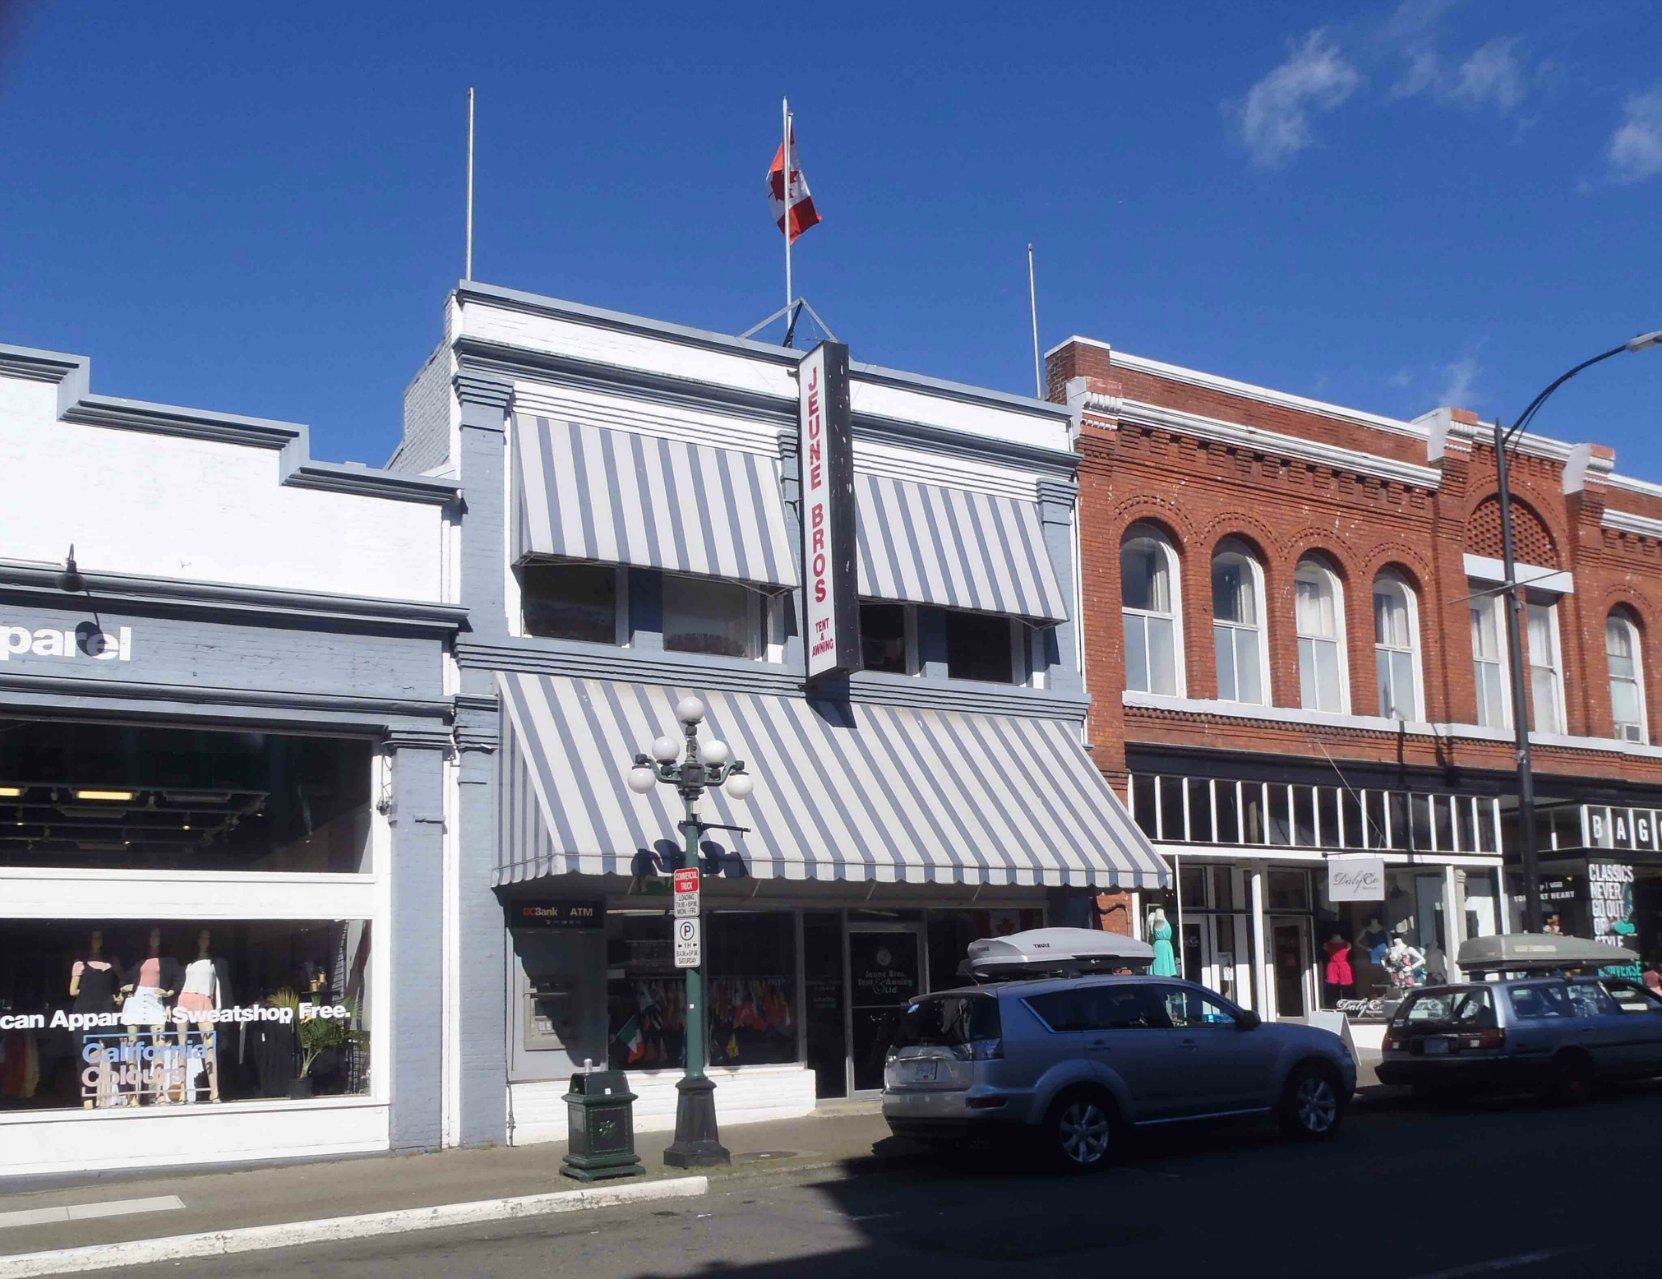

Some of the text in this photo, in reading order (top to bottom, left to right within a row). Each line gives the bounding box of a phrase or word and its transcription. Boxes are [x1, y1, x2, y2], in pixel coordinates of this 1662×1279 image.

[808, 366, 827, 603] JEUNE BROS
[815, 618, 830, 633] TENT
[819, 633, 825, 641] &
[812, 638, 834, 657] AWNING
[1592, 815, 1662, 842] BAG
[1588, 863, 1635, 883] CLASSICS
[680, 882, 693, 891] TRUCK
[1590, 881, 1622, 900] NEVER
[570, 907, 593, 917] ATM
[50, 1010, 132, 1032] Appar
[171, 1004, 293, 1024] Sweatshop
[299, 1002, 351, 1020] Free.
[82, 1041, 208, 1064] California
[81, 1064, 186, 1088] Colours
